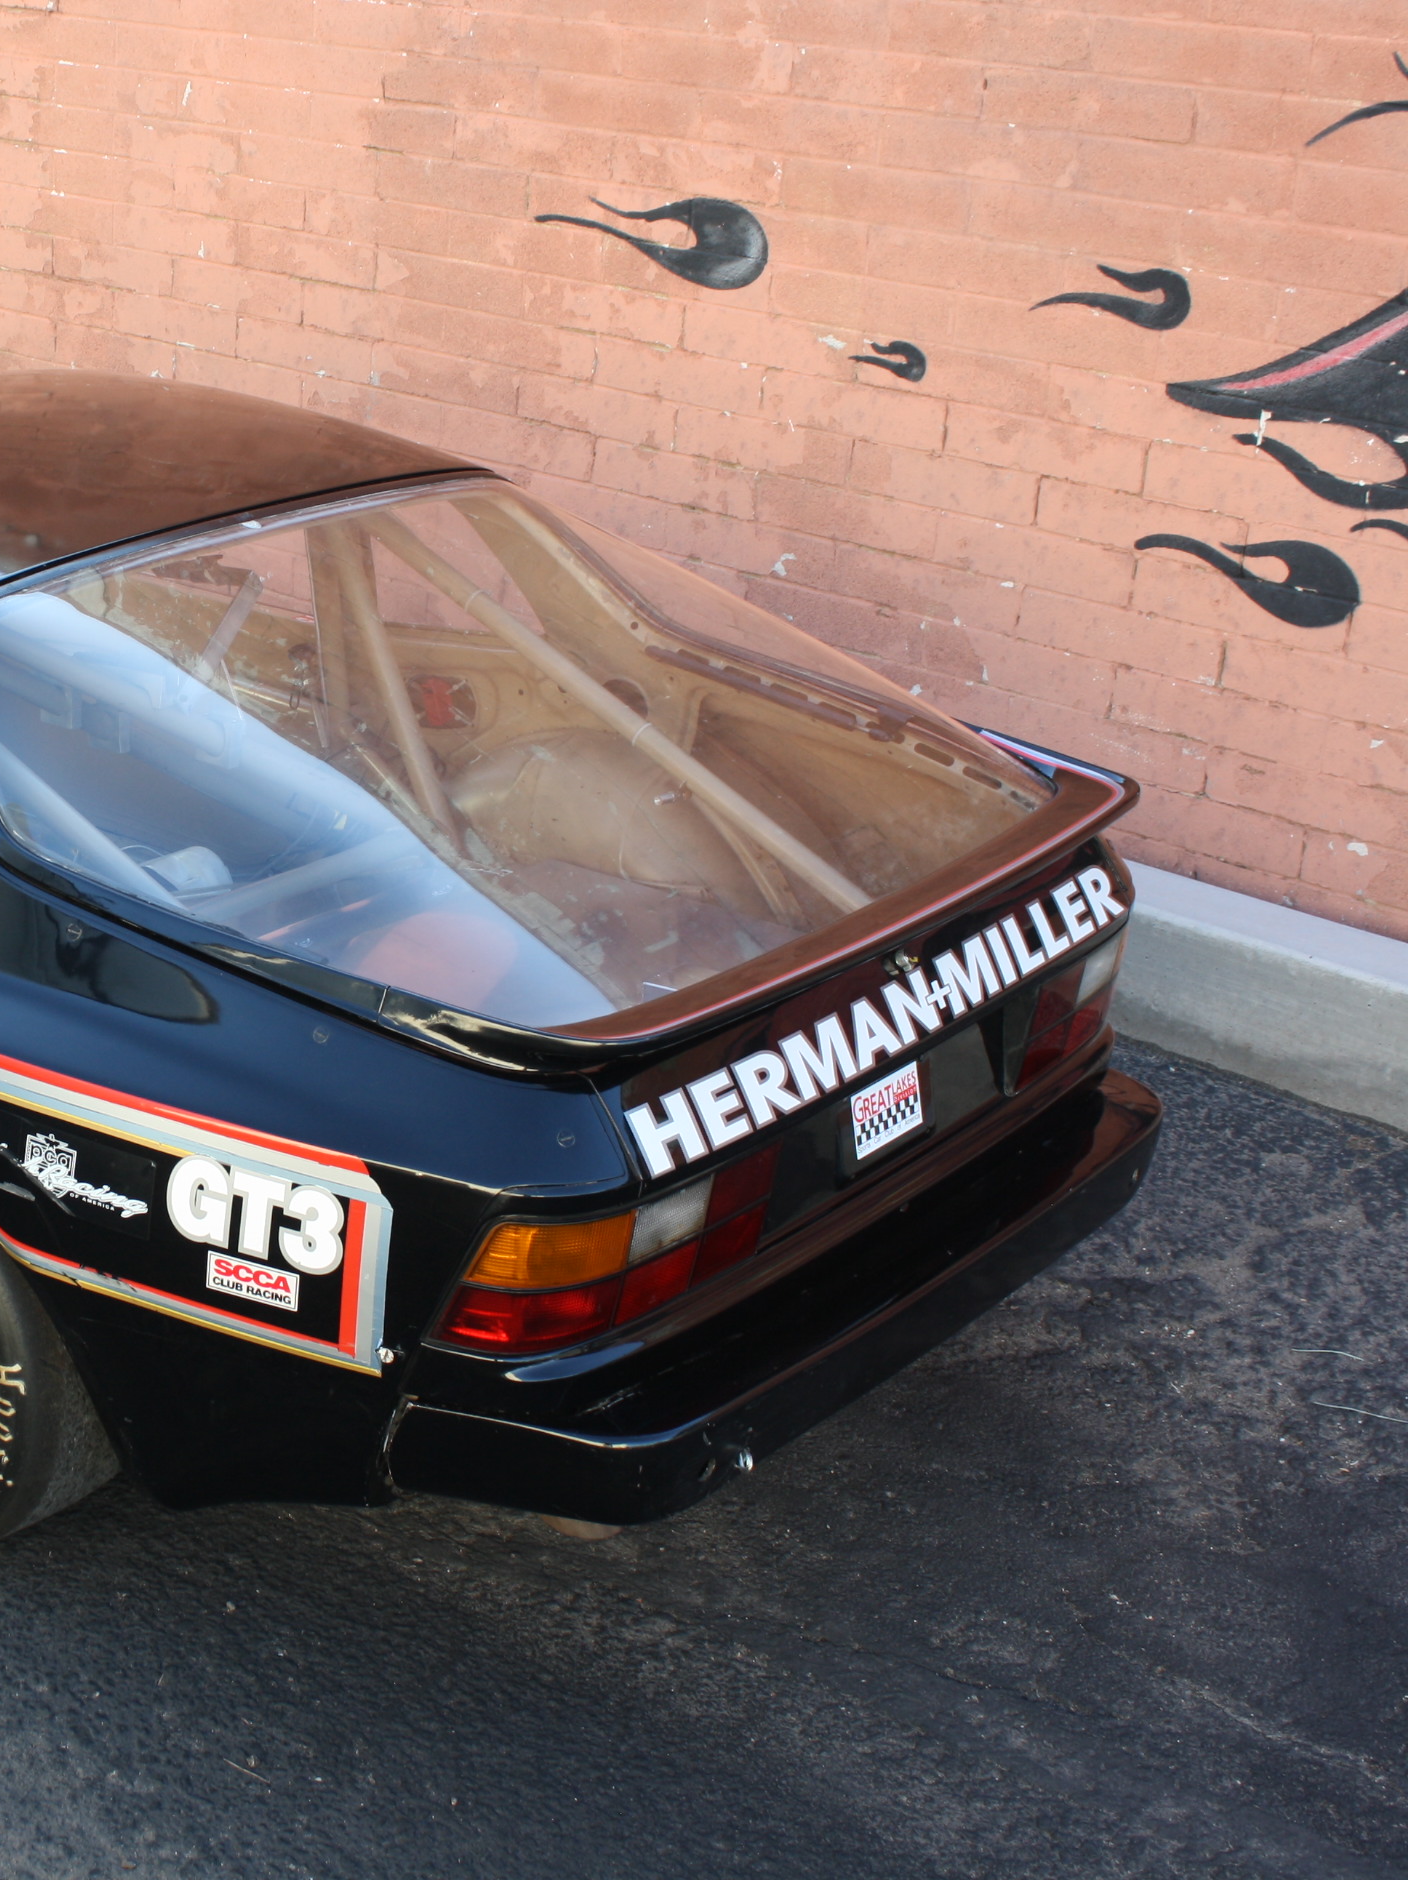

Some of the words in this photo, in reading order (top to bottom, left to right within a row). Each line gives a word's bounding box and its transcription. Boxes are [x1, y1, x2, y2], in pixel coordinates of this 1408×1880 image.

[852, 1084, 892, 1123] GREAT
[891, 1070, 917, 1095] LAKES
[69, 1192, 80, 1201] OF
[81, 1196, 115, 1212] AMERICA
[166, 1153, 345, 1276] GT3
[212, 1276, 244, 1292] CLUB
[246, 1284, 292, 1305] RACING
[213, 1258, 292, 1294] SCCA
